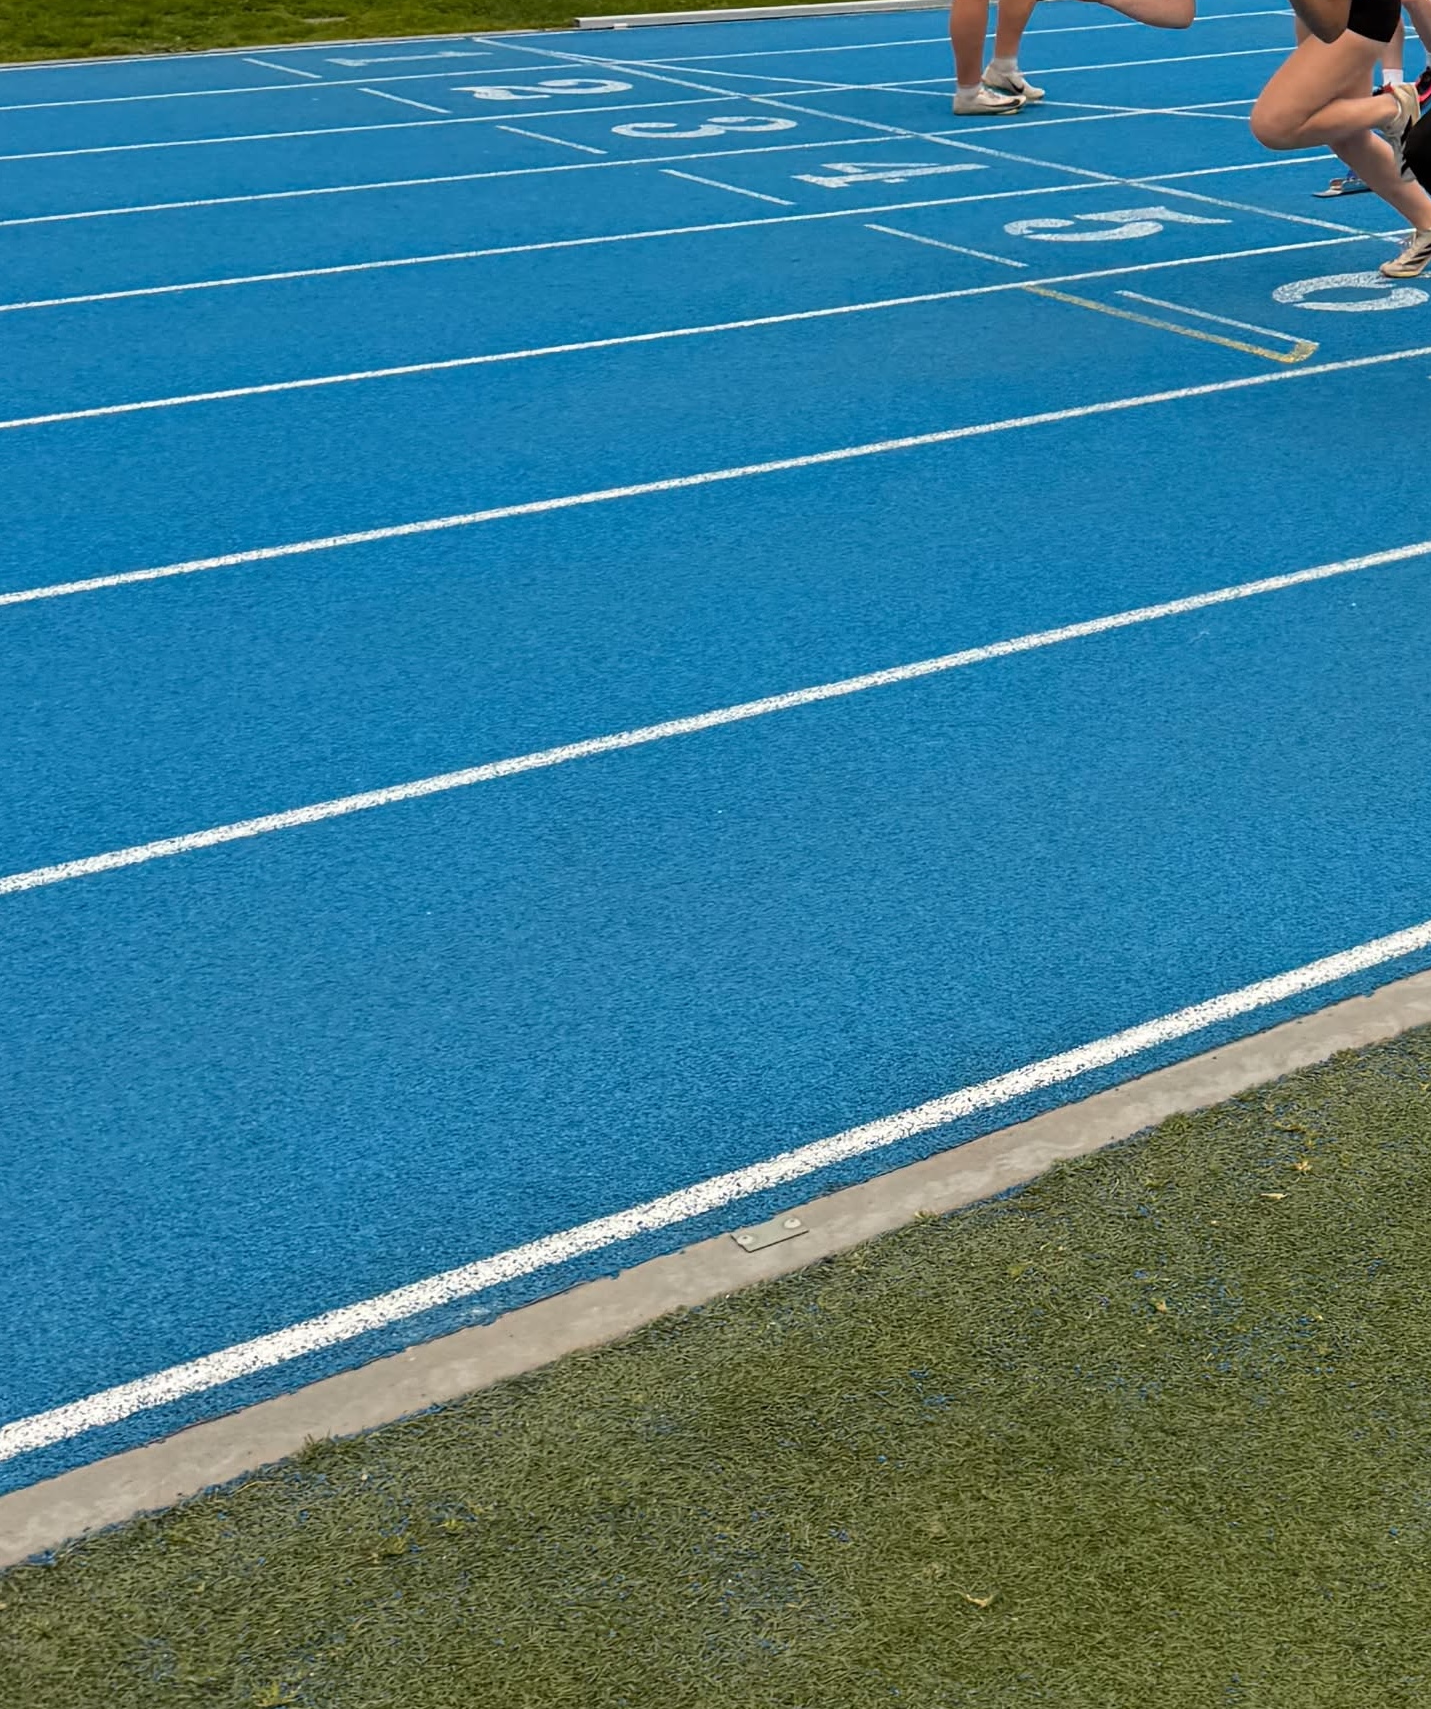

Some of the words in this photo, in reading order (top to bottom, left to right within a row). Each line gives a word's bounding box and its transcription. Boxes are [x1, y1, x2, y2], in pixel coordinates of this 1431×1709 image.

[325, 51, 492, 67] 1
[449, 78, 634, 101] 2
[610, 116, 798, 139] 3
[790, 162, 990, 189] 4
[1002, 205, 1234, 242] 5
